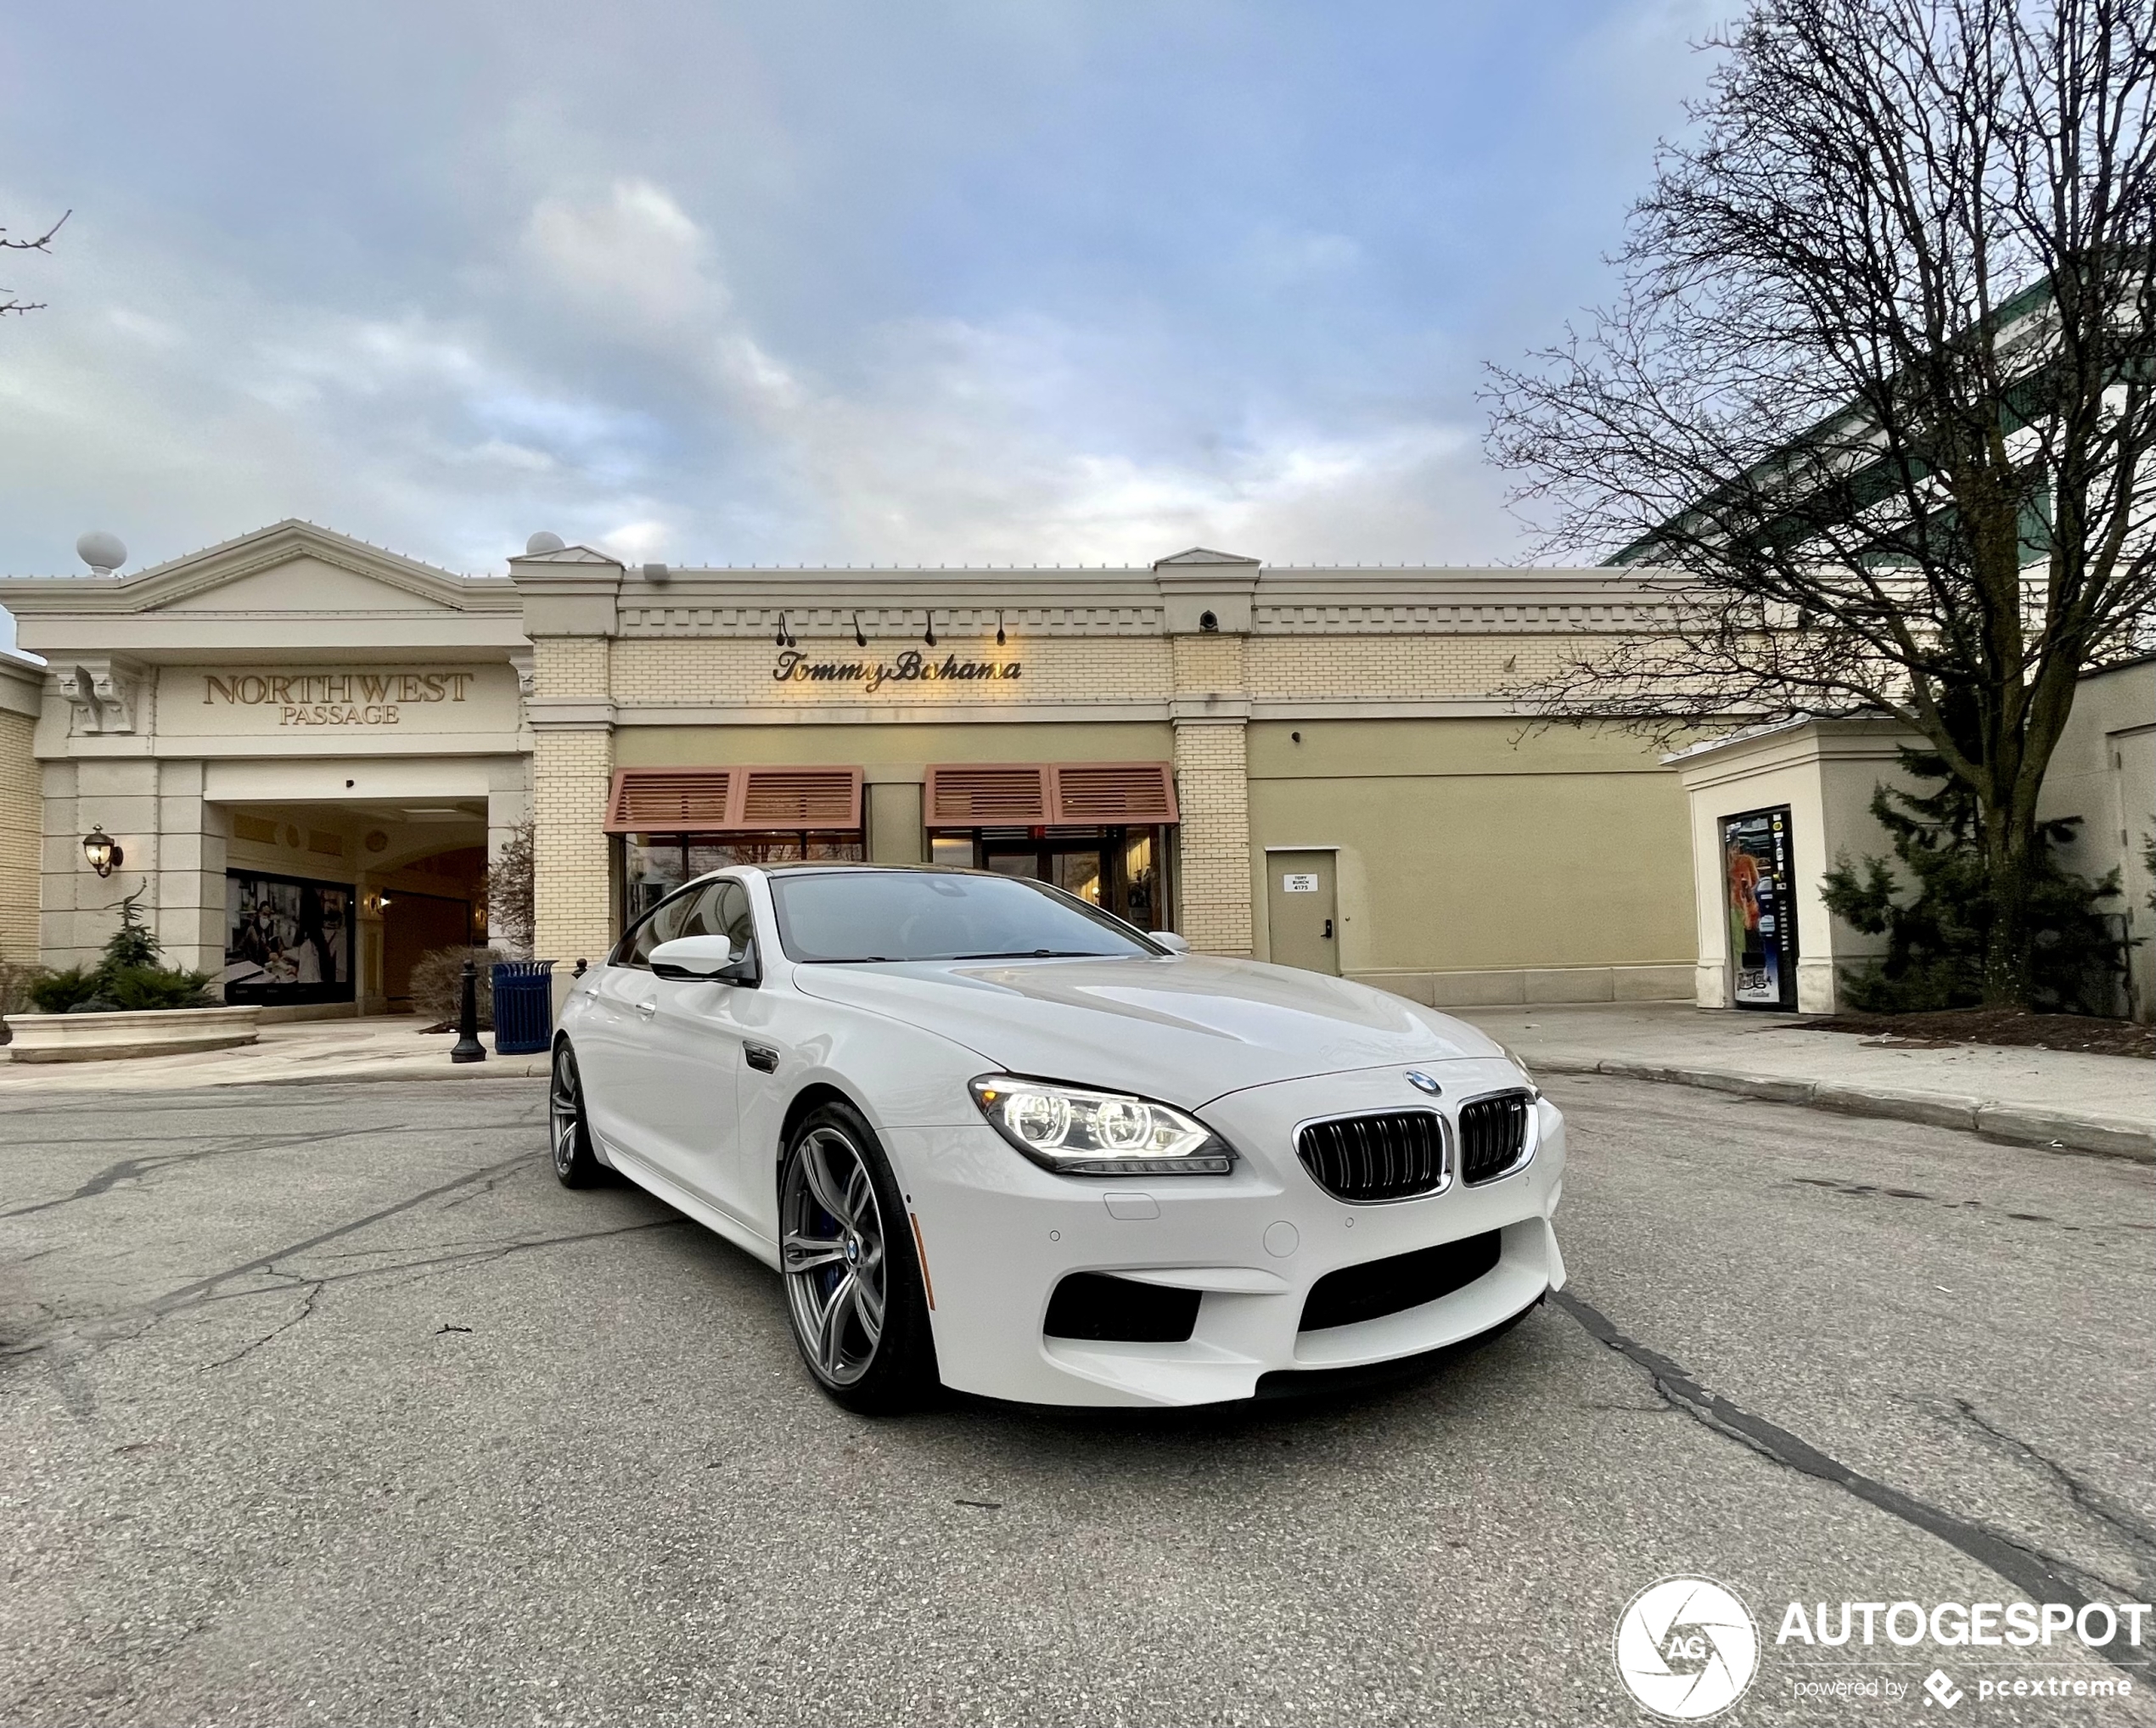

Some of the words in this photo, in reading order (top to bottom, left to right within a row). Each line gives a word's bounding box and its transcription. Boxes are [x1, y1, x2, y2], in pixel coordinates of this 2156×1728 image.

[773, 651, 891, 693] Tommy
[891, 650, 1022, 681] Bahama
[279, 705, 400, 725] PASSAGE
